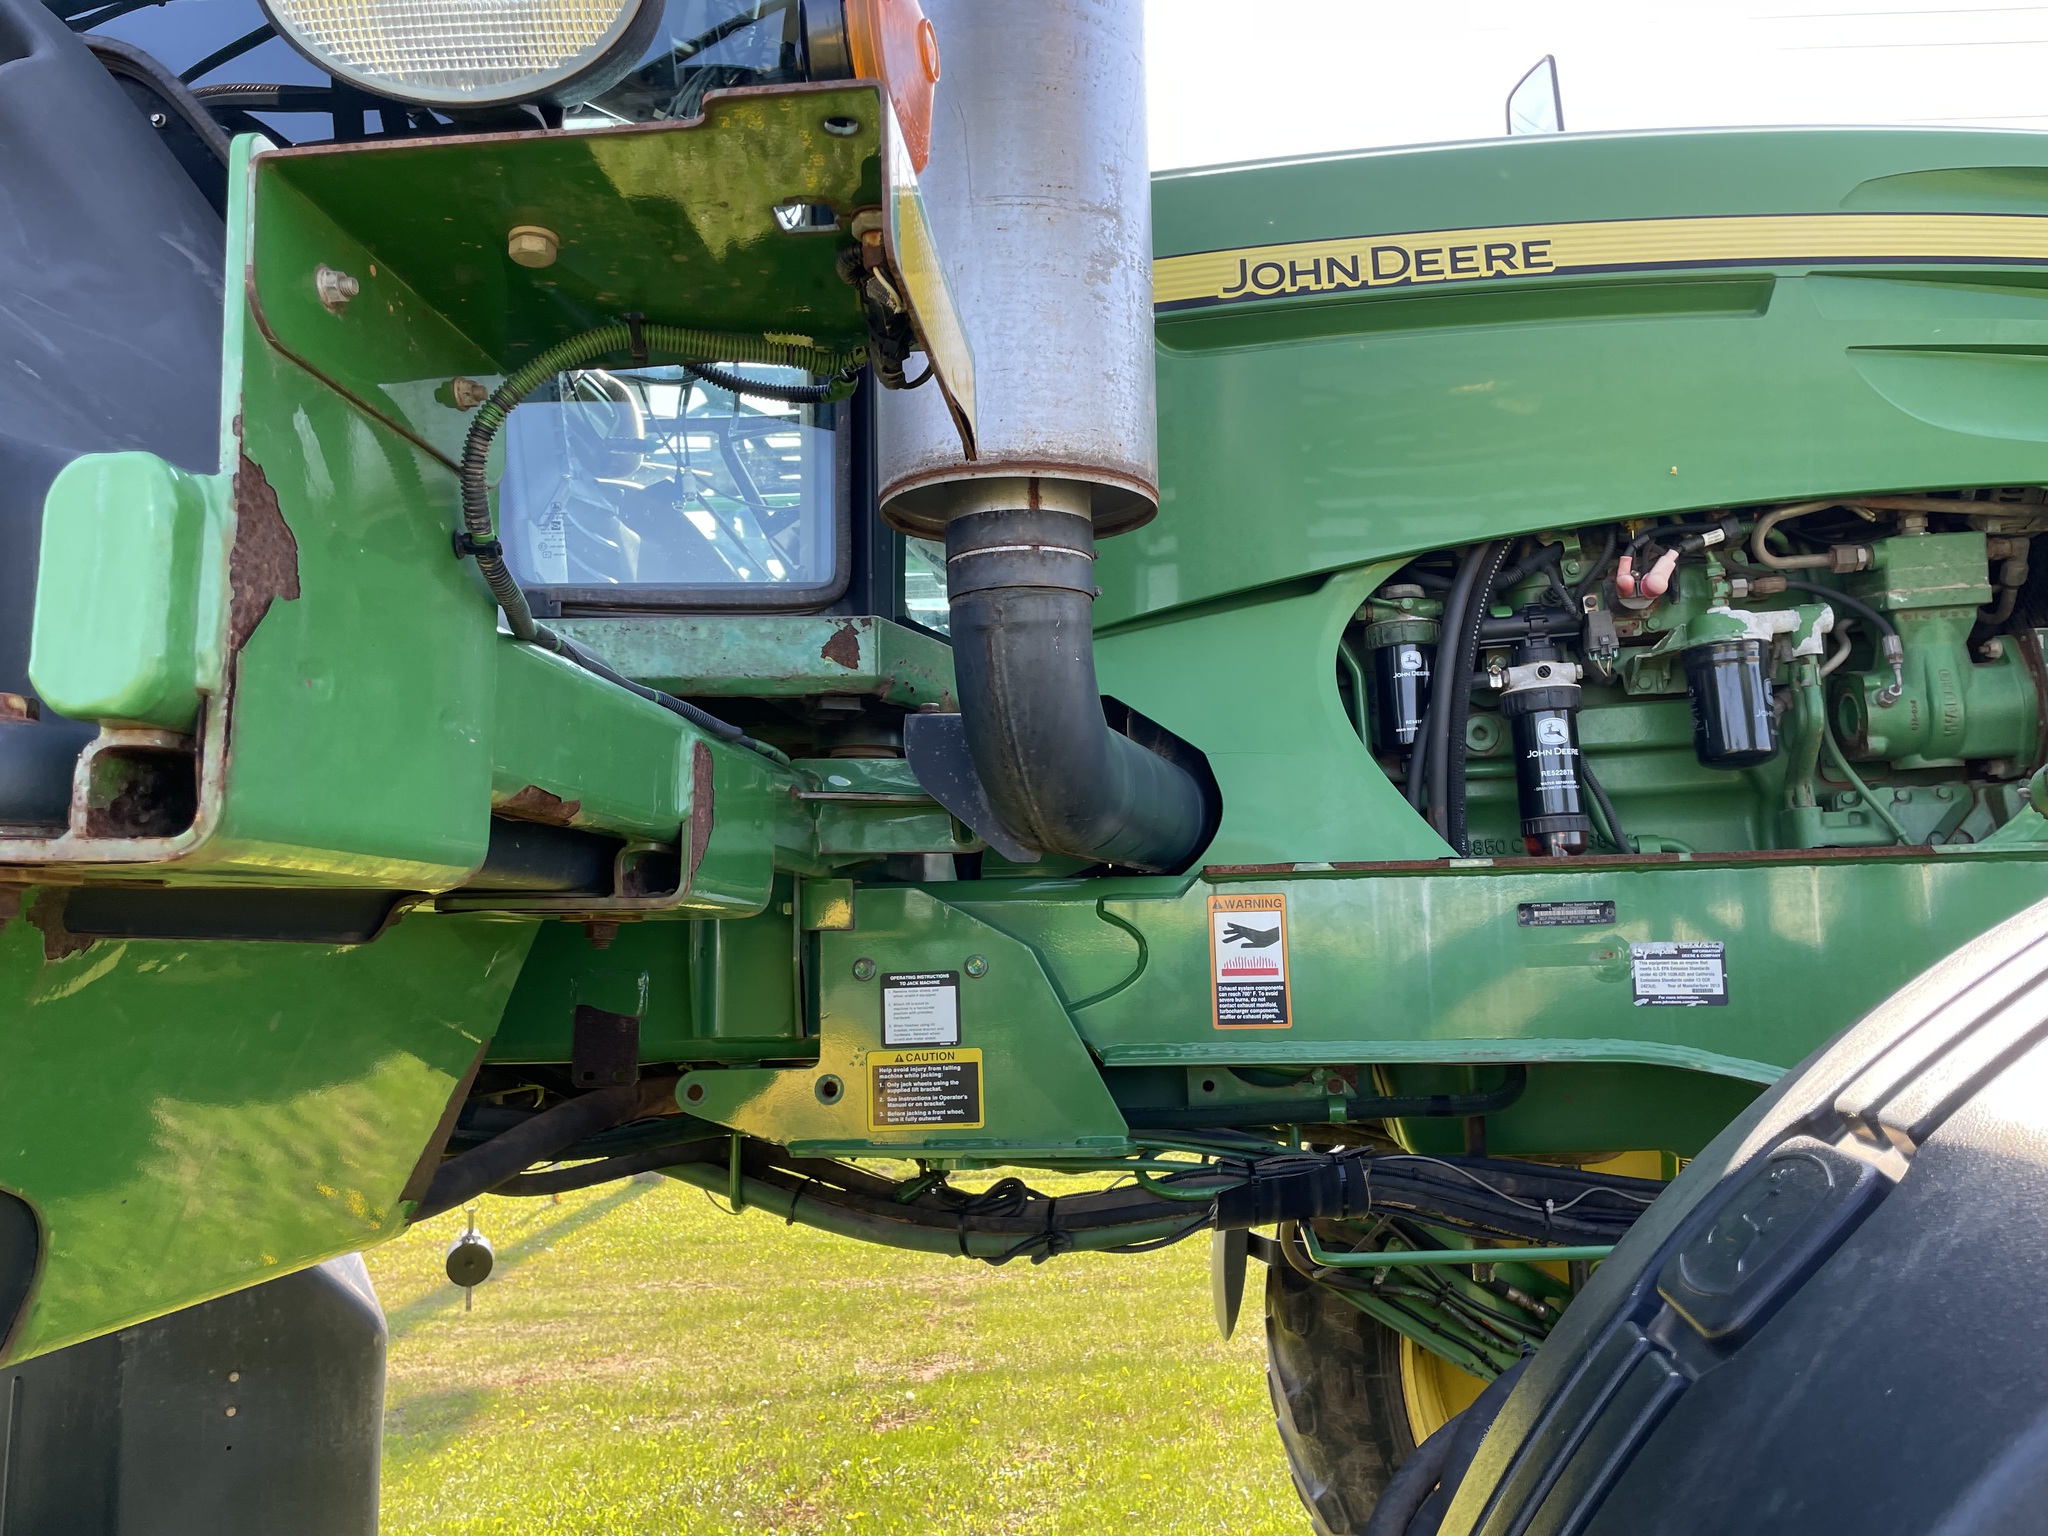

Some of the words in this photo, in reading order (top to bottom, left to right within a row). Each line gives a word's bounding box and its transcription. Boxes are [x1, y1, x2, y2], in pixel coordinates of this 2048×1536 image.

[1222, 255, 1359, 294] JOHN
[1370, 239, 1554, 280] DEERE
[1526, 749, 1552, 758] JOHN
[1554, 747, 1579, 756] DEERE
[1225, 899, 1282, 908] WARNING
[906, 1052, 955, 1062] CAUTION
